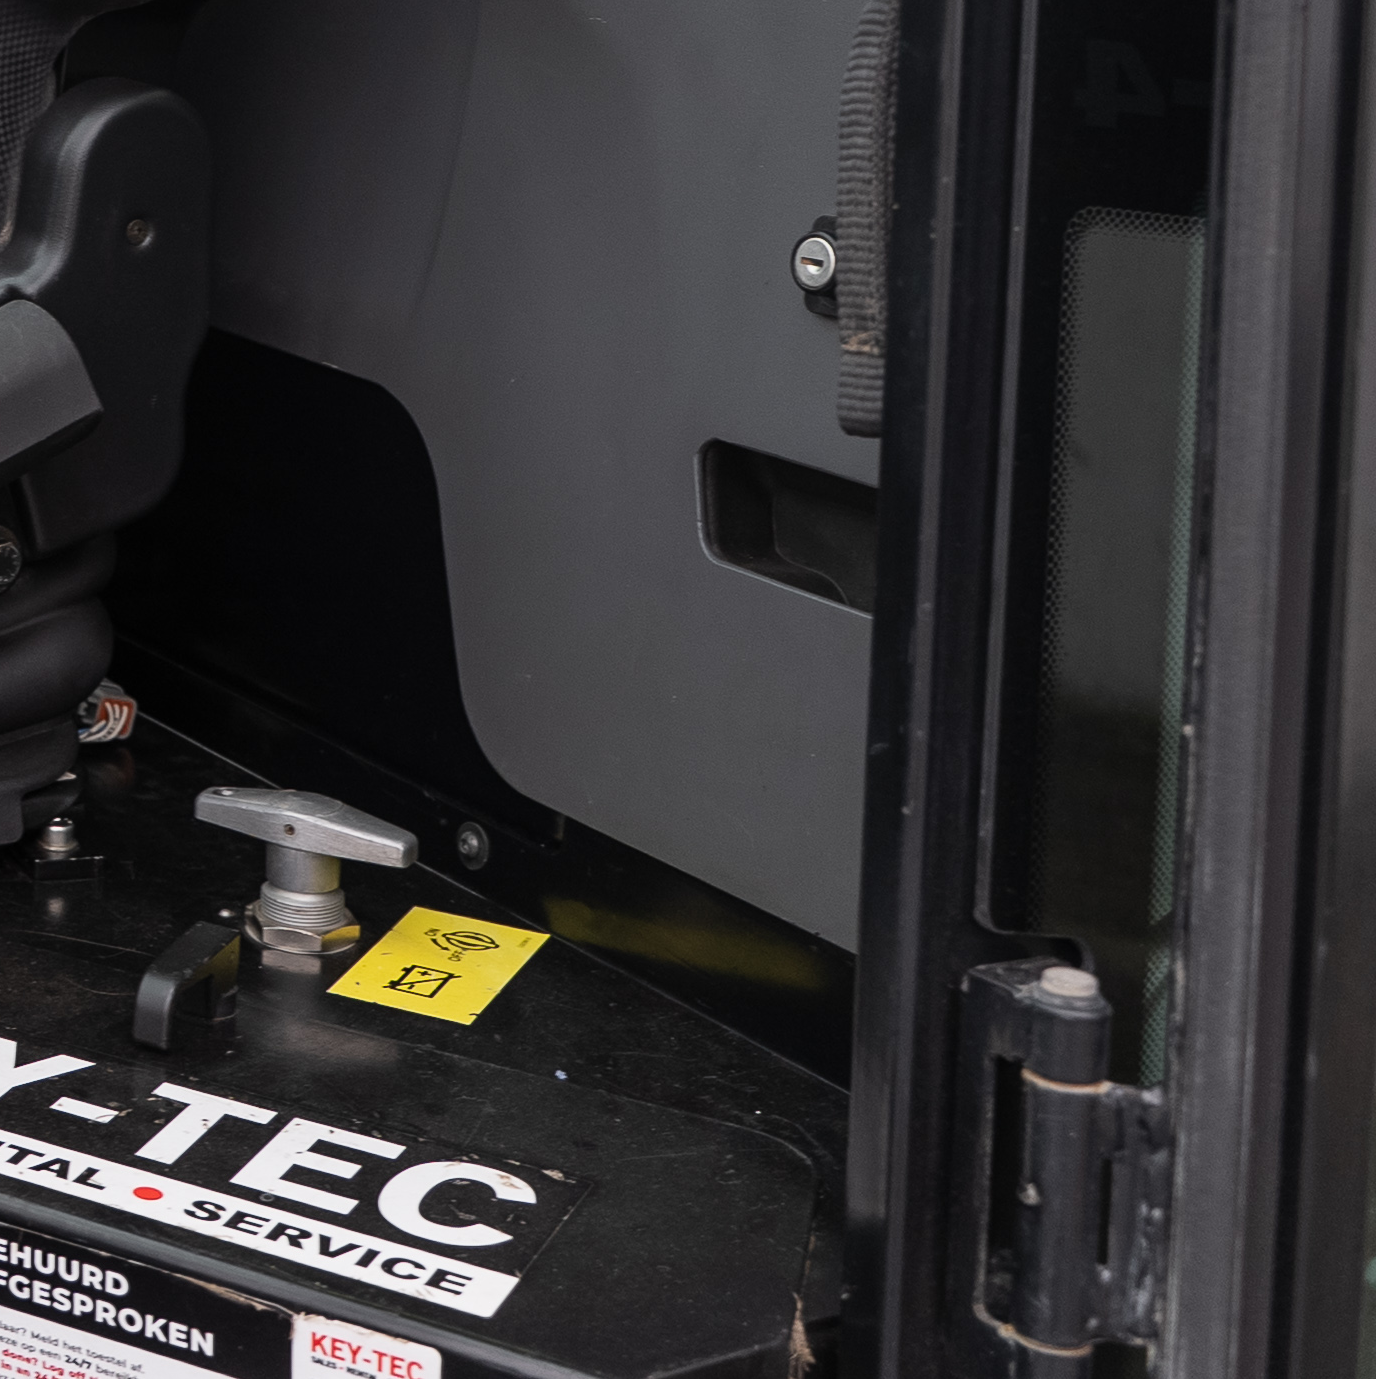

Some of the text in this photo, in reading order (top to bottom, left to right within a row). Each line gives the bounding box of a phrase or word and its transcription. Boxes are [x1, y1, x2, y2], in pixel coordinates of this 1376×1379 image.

[182, 1199, 474, 1297] SERVICE
[1, 1348, 39, 1366] done?
[64, 1354, 92, 1370] 24/7
[310, 1331, 424, 1379] KEY-TEC
